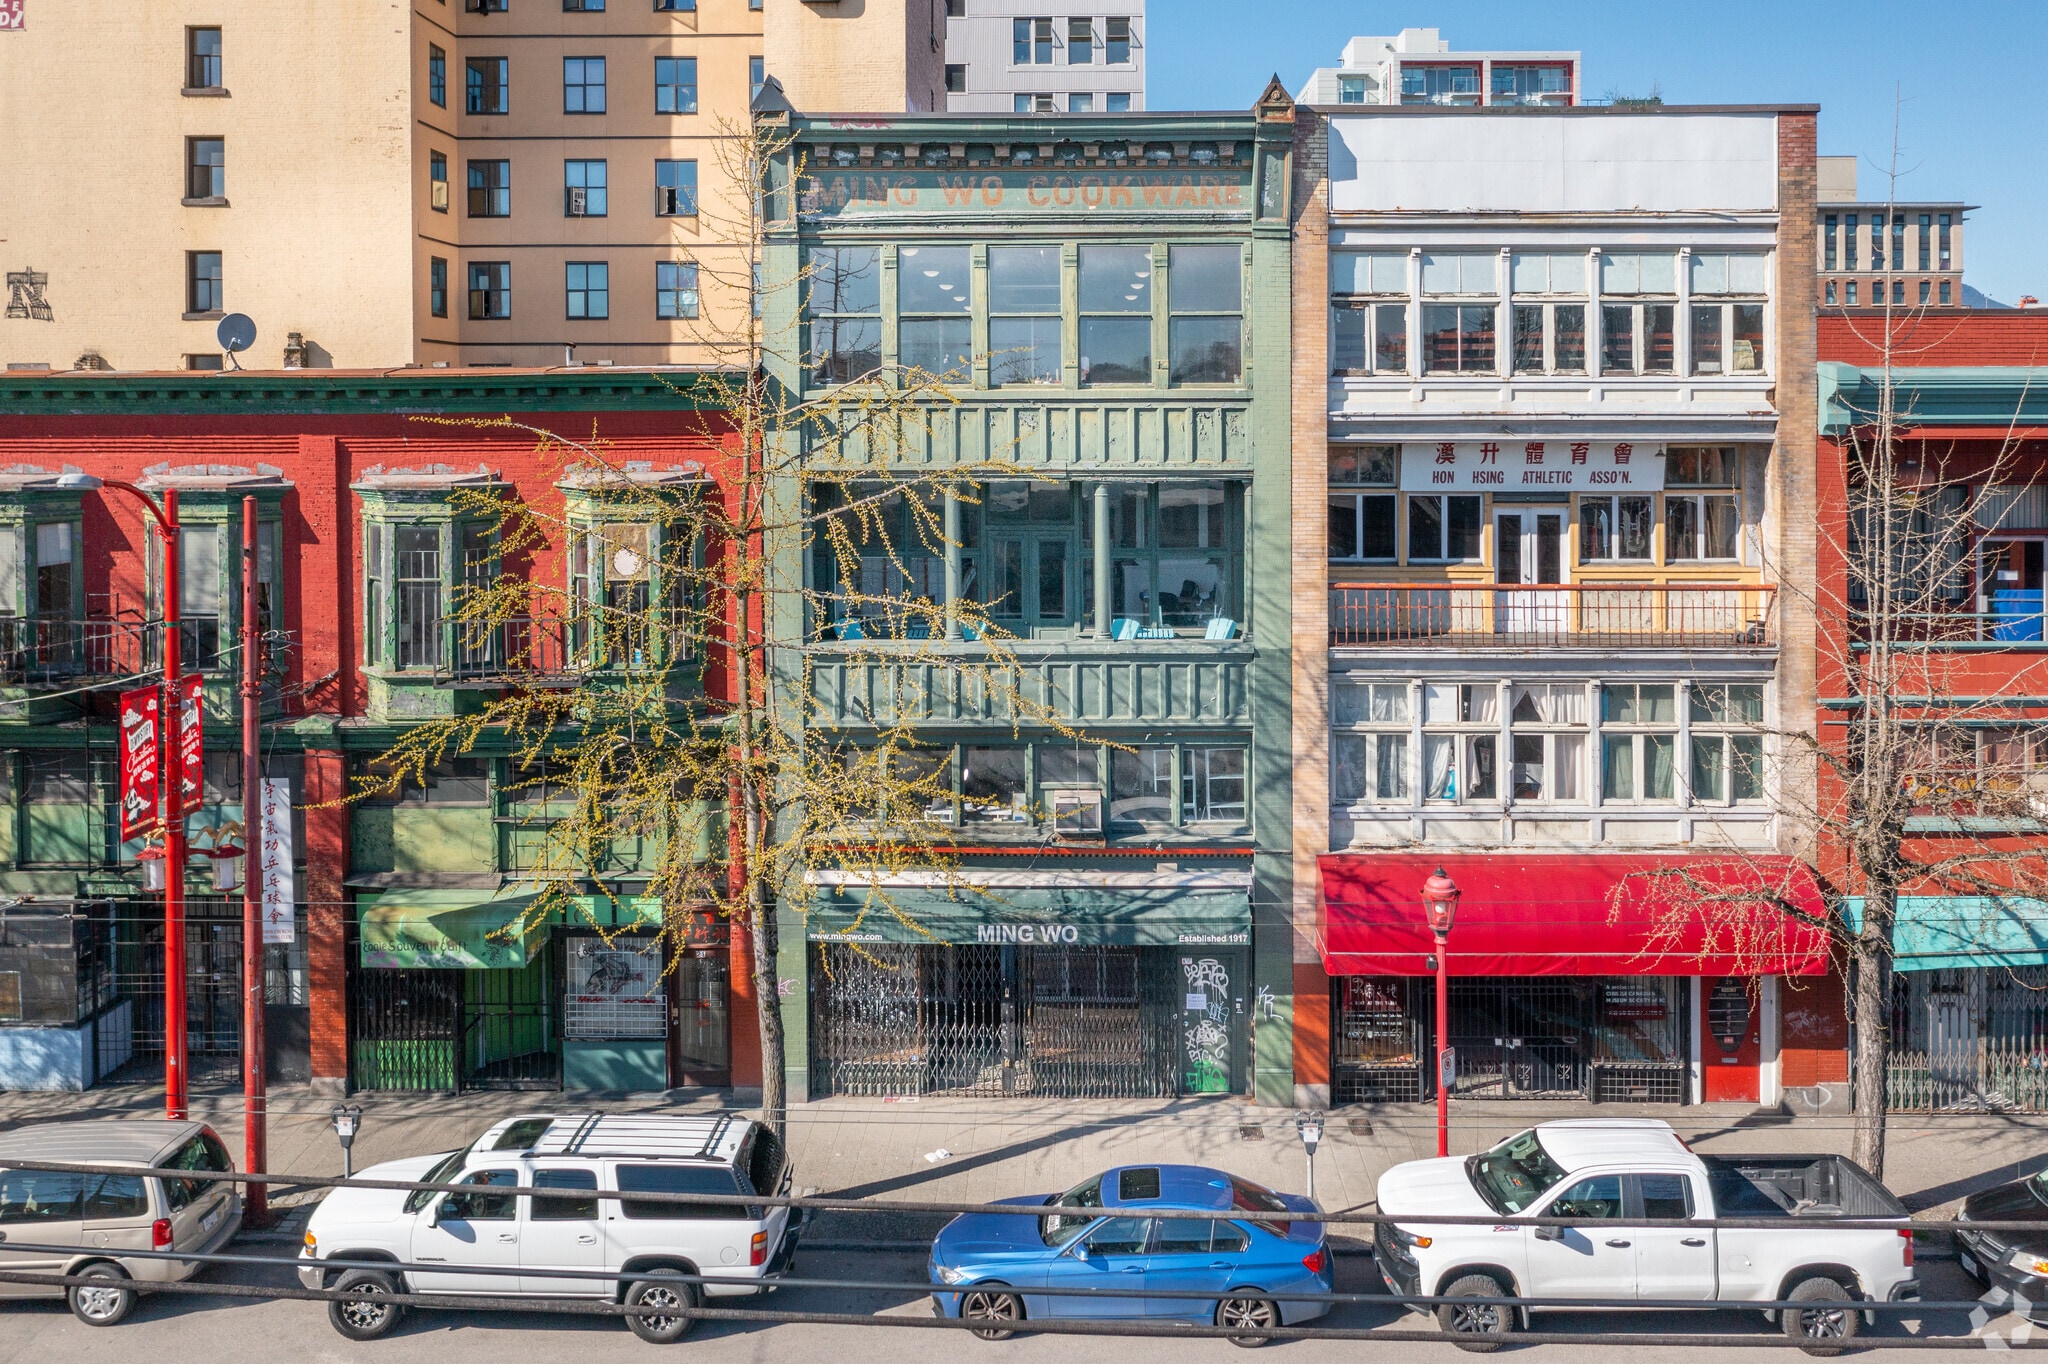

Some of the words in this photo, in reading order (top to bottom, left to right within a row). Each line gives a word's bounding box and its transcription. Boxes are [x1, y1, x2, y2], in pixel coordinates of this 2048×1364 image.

[812, 175, 918, 207] MING
[938, 175, 1003, 207] WO
[1028, 175, 1242, 207] COOKWARE
[1435, 442, 1633, 465] 漢升體育會
[1432, 471, 1455, 484] HON
[1472, 471, 1504, 484] HSING
[1522, 471, 1573, 484] ATHLETIC
[1589, 471, 1633, 484] ASSO'N.
[809, 932, 883, 942] www.mingwo.com
[976, 924, 1033, 942] MING
[1039, 924, 1078, 942] WO
[1178, 932, 1226, 943] Established
[1227, 933, 1248, 943] 1917
[363, 940, 387, 955] Eagle
